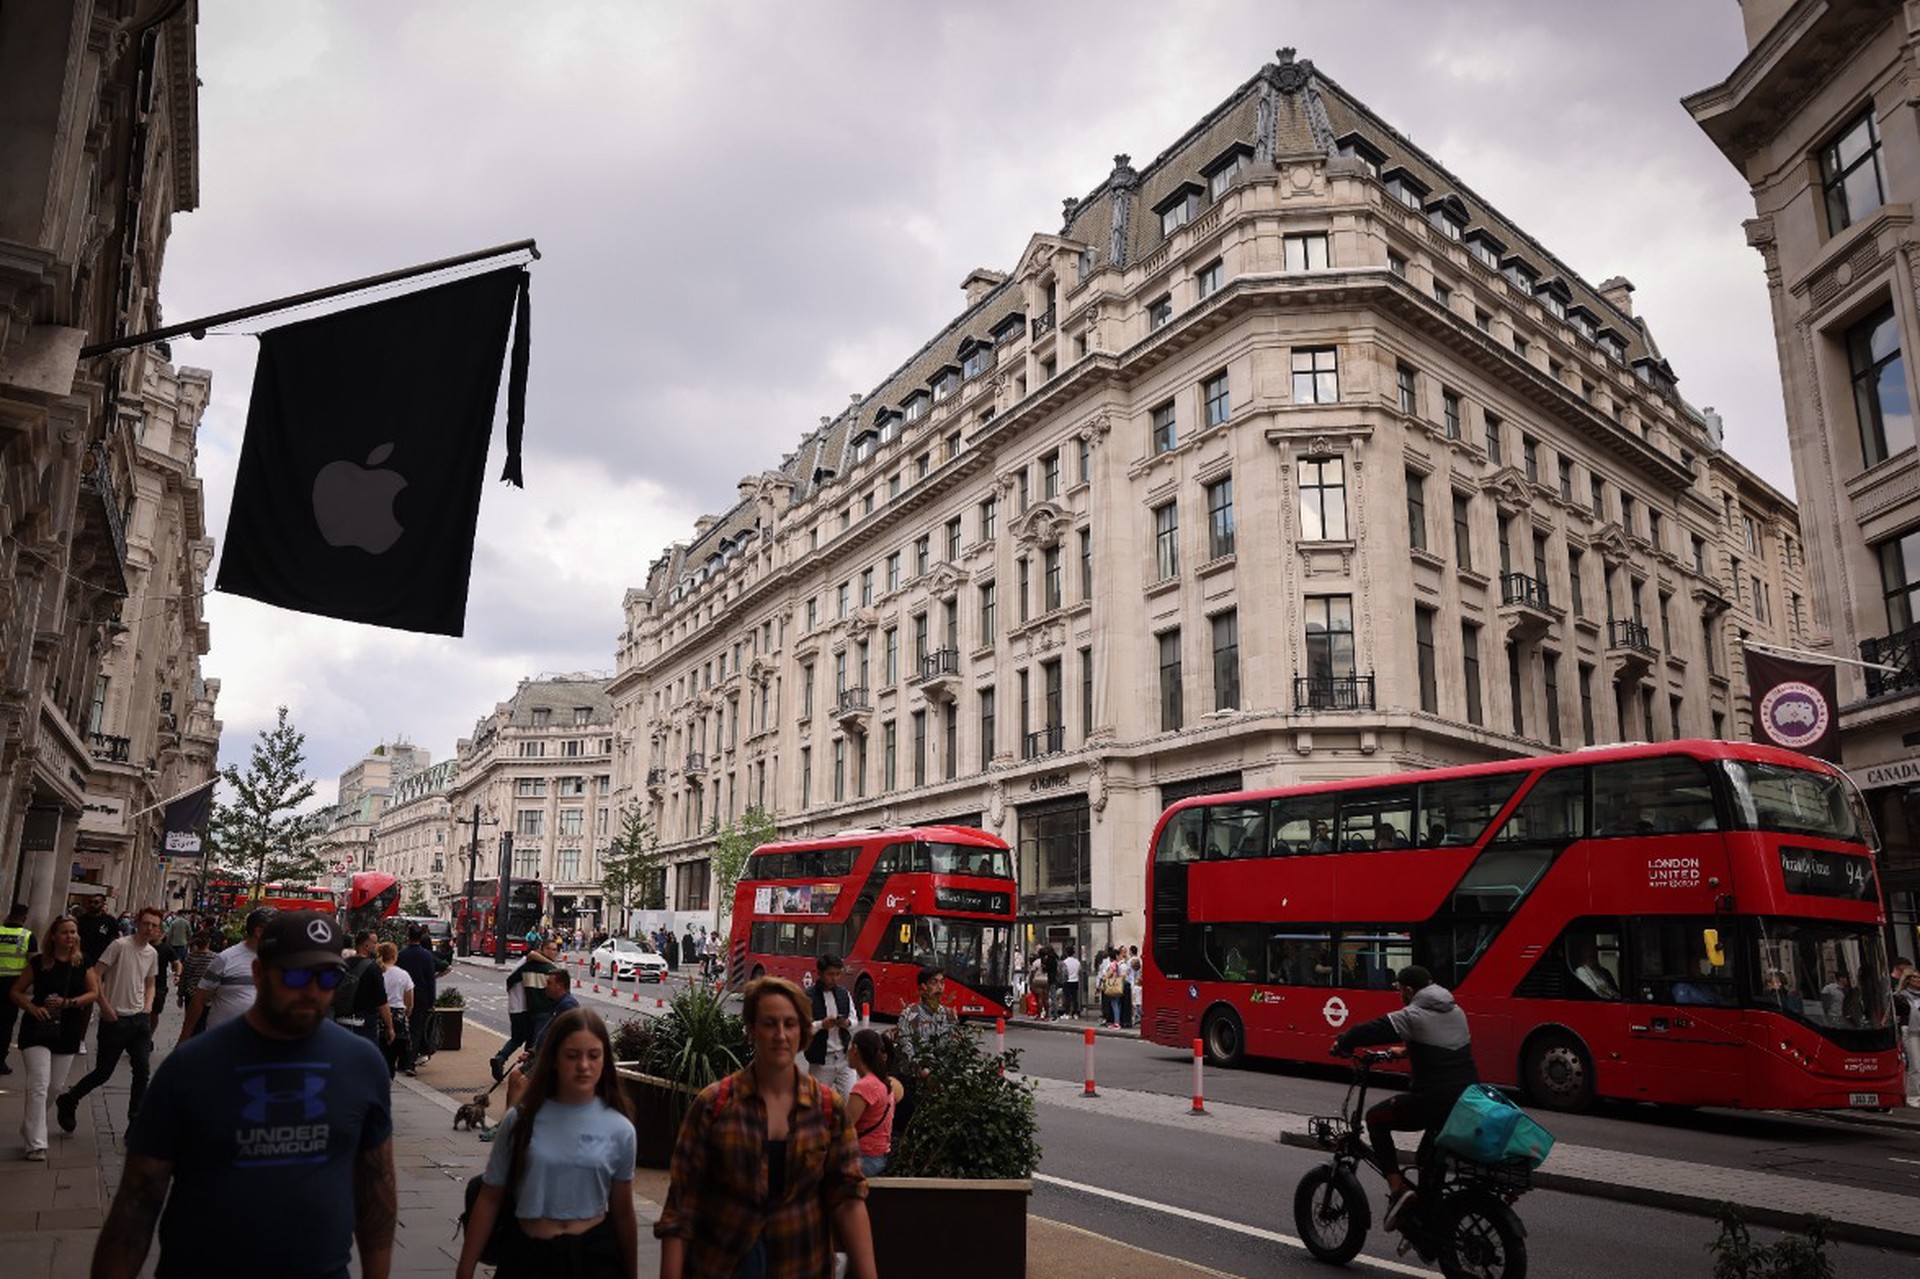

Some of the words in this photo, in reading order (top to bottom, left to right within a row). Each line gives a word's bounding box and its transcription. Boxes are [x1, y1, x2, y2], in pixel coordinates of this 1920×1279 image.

[1867, 762, 1920, 784] CANADA
[1647, 858, 1700, 868] LONDON
[1647, 869, 1700, 879] UNITED
[1845, 861, 1865, 885] 94
[990, 895, 1002, 910] 12
[236, 1124, 330, 1145] UNDER
[237, 1139, 327, 1157] ARMOUR
